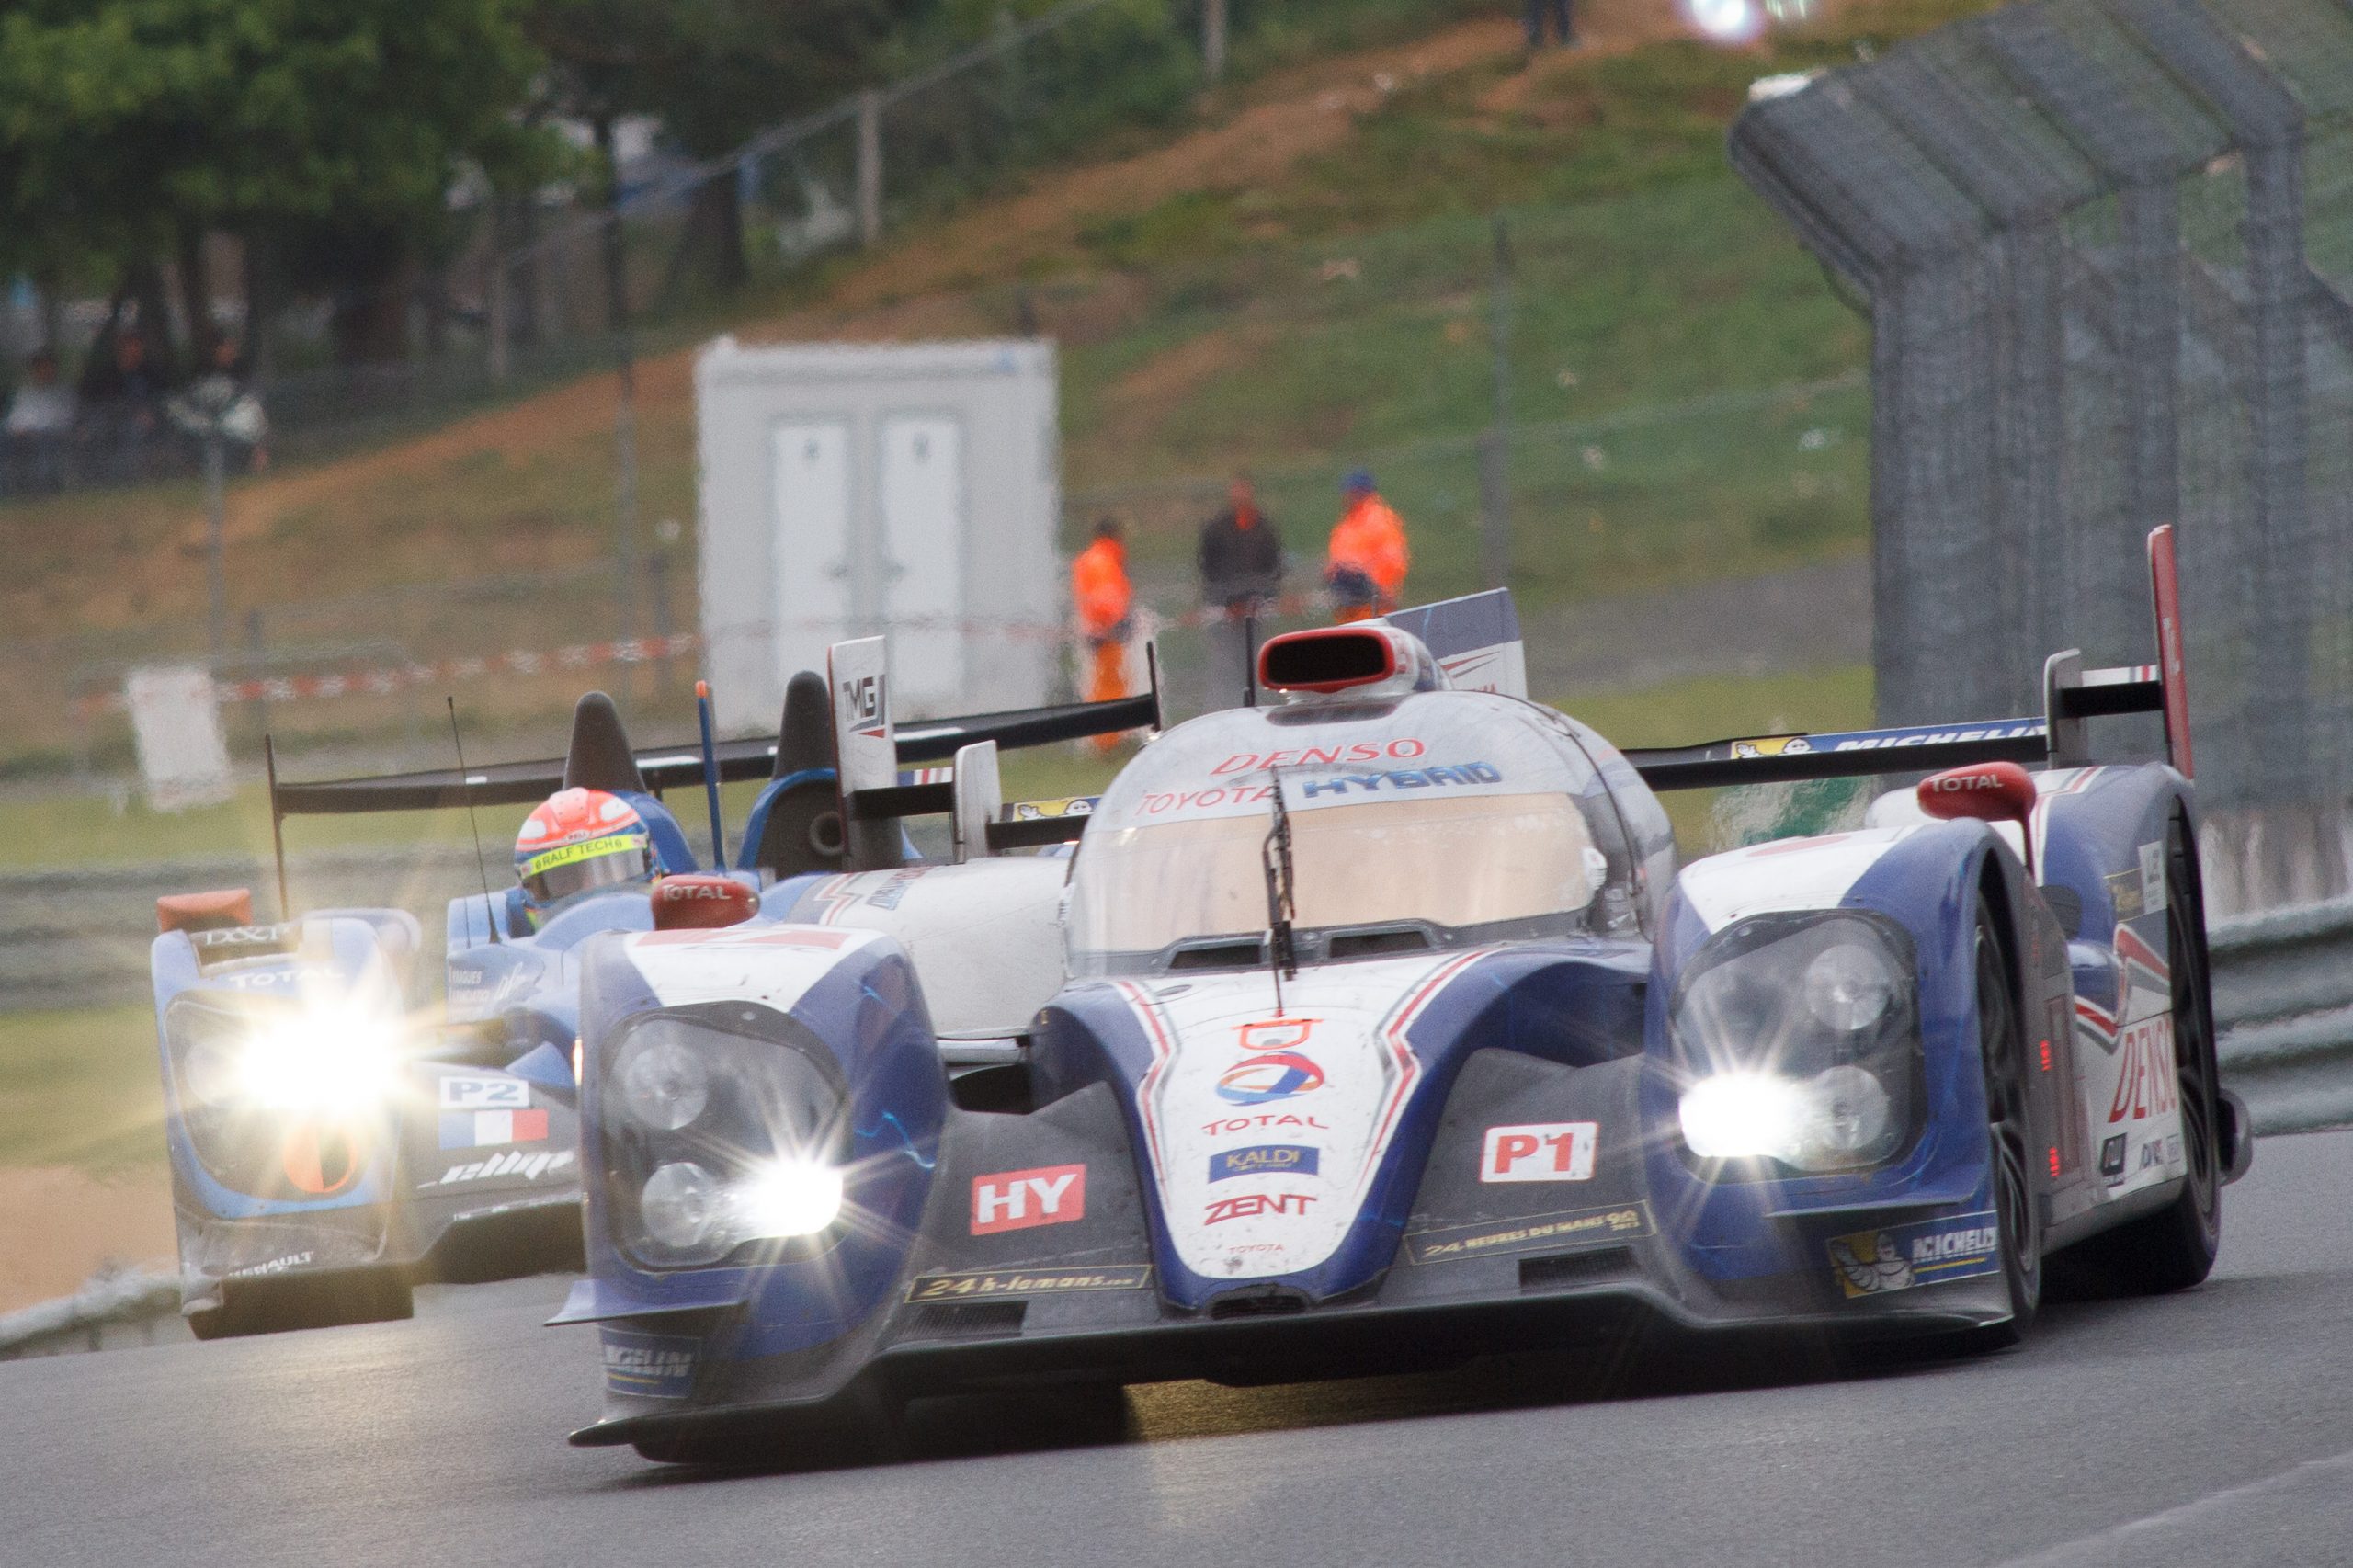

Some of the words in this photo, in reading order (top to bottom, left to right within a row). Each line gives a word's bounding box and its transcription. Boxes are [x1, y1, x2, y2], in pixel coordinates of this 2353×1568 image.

[1209, 738, 1426, 776] DENSO
[1136, 785, 1276, 817] TOYOTA
[1303, 761, 1502, 799] HYBRID
[1931, 773, 2004, 793] TOTAL
[542, 846, 574, 866] RALF
[579, 839, 614, 855] TECH
[662, 883, 733, 902] TOTAL
[231, 968, 346, 989] TOTAL
[449, 1081, 519, 1102] P2
[1201, 1114, 1330, 1137] TOTAL
[1227, 1149, 1301, 1169] KALDI
[1493, 1132, 1574, 1175] P1
[977, 1173, 1077, 1225] HY
[1204, 1193, 1318, 1226] ZENT
[1229, 1244, 1284, 1256] TOYOTA
[1424, 1242, 1462, 1258] 24
